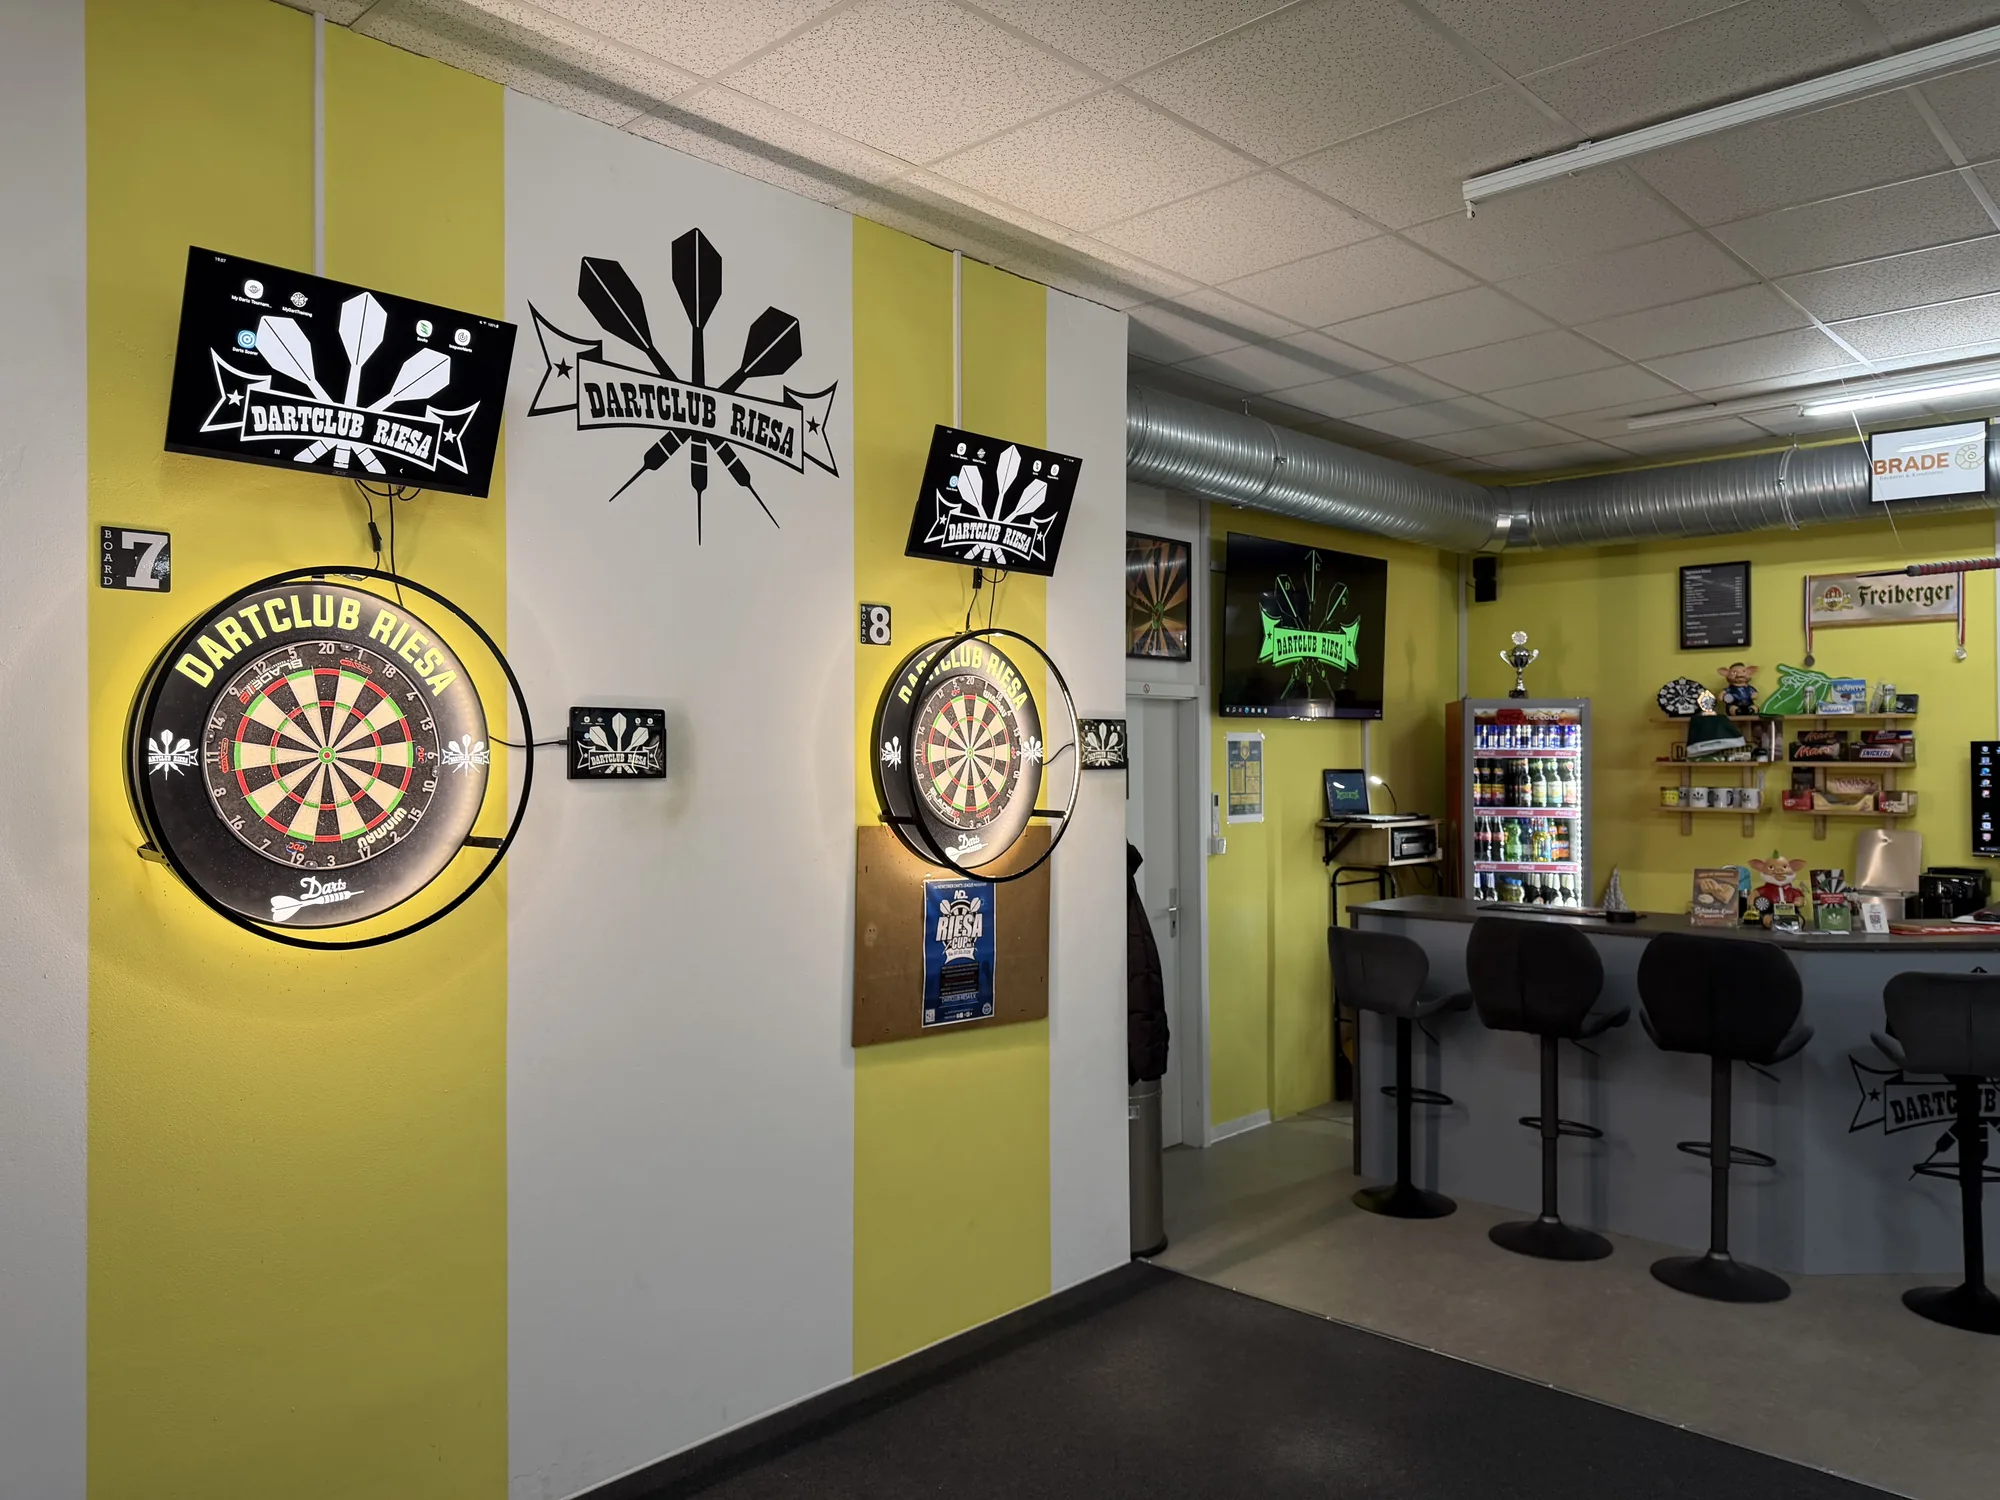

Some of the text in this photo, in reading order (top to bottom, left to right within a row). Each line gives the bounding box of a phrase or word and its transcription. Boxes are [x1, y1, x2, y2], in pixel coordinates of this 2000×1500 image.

[583, 382, 795, 459] DARTCLUB RIESA
[251, 405, 434, 460] DARTCLUB RIESA
[1873, 452, 1950, 476] BRADE
[948, 523, 1032, 553] DARTCLUB RIESA
[103, 529, 114, 586] BOARD
[122, 531, 168, 589] 7
[1858, 583, 1954, 607] Freiberger
[869, 606, 891, 644] 8
[174, 593, 458, 698] DARTCLUB RIESA
[318, 643, 335, 655] 20
[1276, 634, 1343, 661] DARTCLUB RIESA
[287, 647, 298, 659] 5
[358, 649, 364, 660] 1
[252, 661, 270, 676] 12
[252, 658, 304, 691] BLADE
[381, 664, 397, 678] 18
[966, 676, 975, 685] 20
[985, 652, 1028, 712] RIESA
[228, 687, 242, 698] 9
[405, 691, 417, 702] 4
[210, 716, 226, 730] 14
[420, 716, 433, 731] 13
[206, 751, 220, 764] 11
[590, 753, 625, 766] DARTCLUB
[1861, 748, 1893, 757] SNICKERS
[213, 787, 227, 798] 8
[422, 780, 435, 793] 10
[1006, 788, 1014, 799] 15
[408, 807, 422, 822] 15
[229, 814, 246, 831] 16
[969, 820, 974, 828] 3
[259, 838, 271, 850] 7
[389, 831, 400, 844] 2
[290, 851, 305, 866] 19
[357, 846, 371, 860] 17
[327, 855, 336, 867] 3
[300, 876, 347, 900] Darts
[935, 913, 983, 942] RIESA
[951, 936, 967, 950] CUP
[1889, 1088, 1996, 1125] DARTCB
